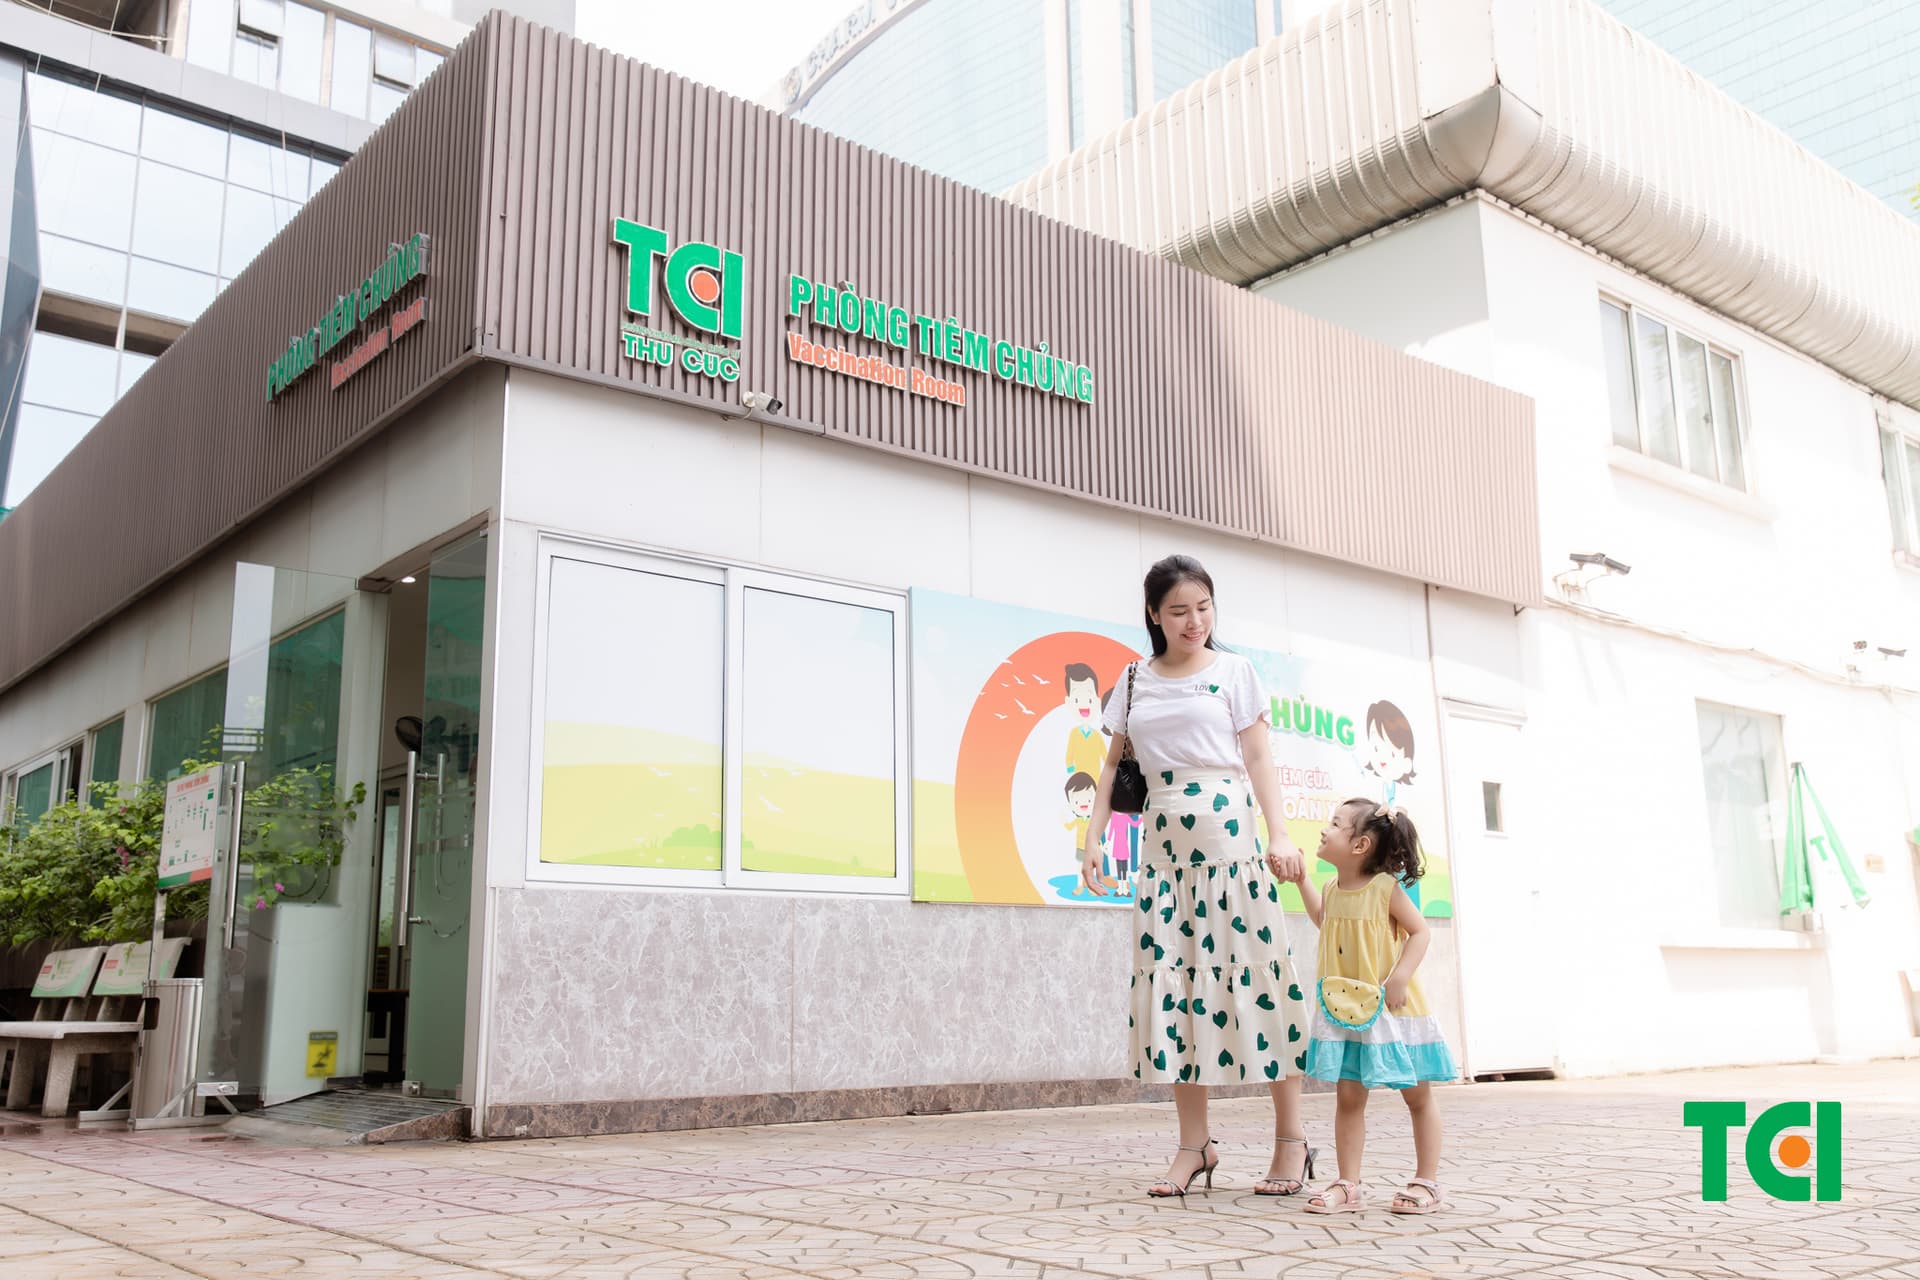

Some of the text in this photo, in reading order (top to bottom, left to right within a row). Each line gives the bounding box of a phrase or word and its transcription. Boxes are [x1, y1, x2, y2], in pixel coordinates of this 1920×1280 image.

[613, 216, 744, 340] TCI
[622, 331, 673, 367] THU
[786, 331, 907, 391] Vaccination
[910, 366, 966, 407] Room
[788, 273, 910, 350] PHÒNG
[914, 315, 991, 375] TIÊM
[994, 340, 1095, 405] CHỦNG
[1271, 694, 1355, 746] HỦNG
[1282, 791, 1323, 822] OÀN
